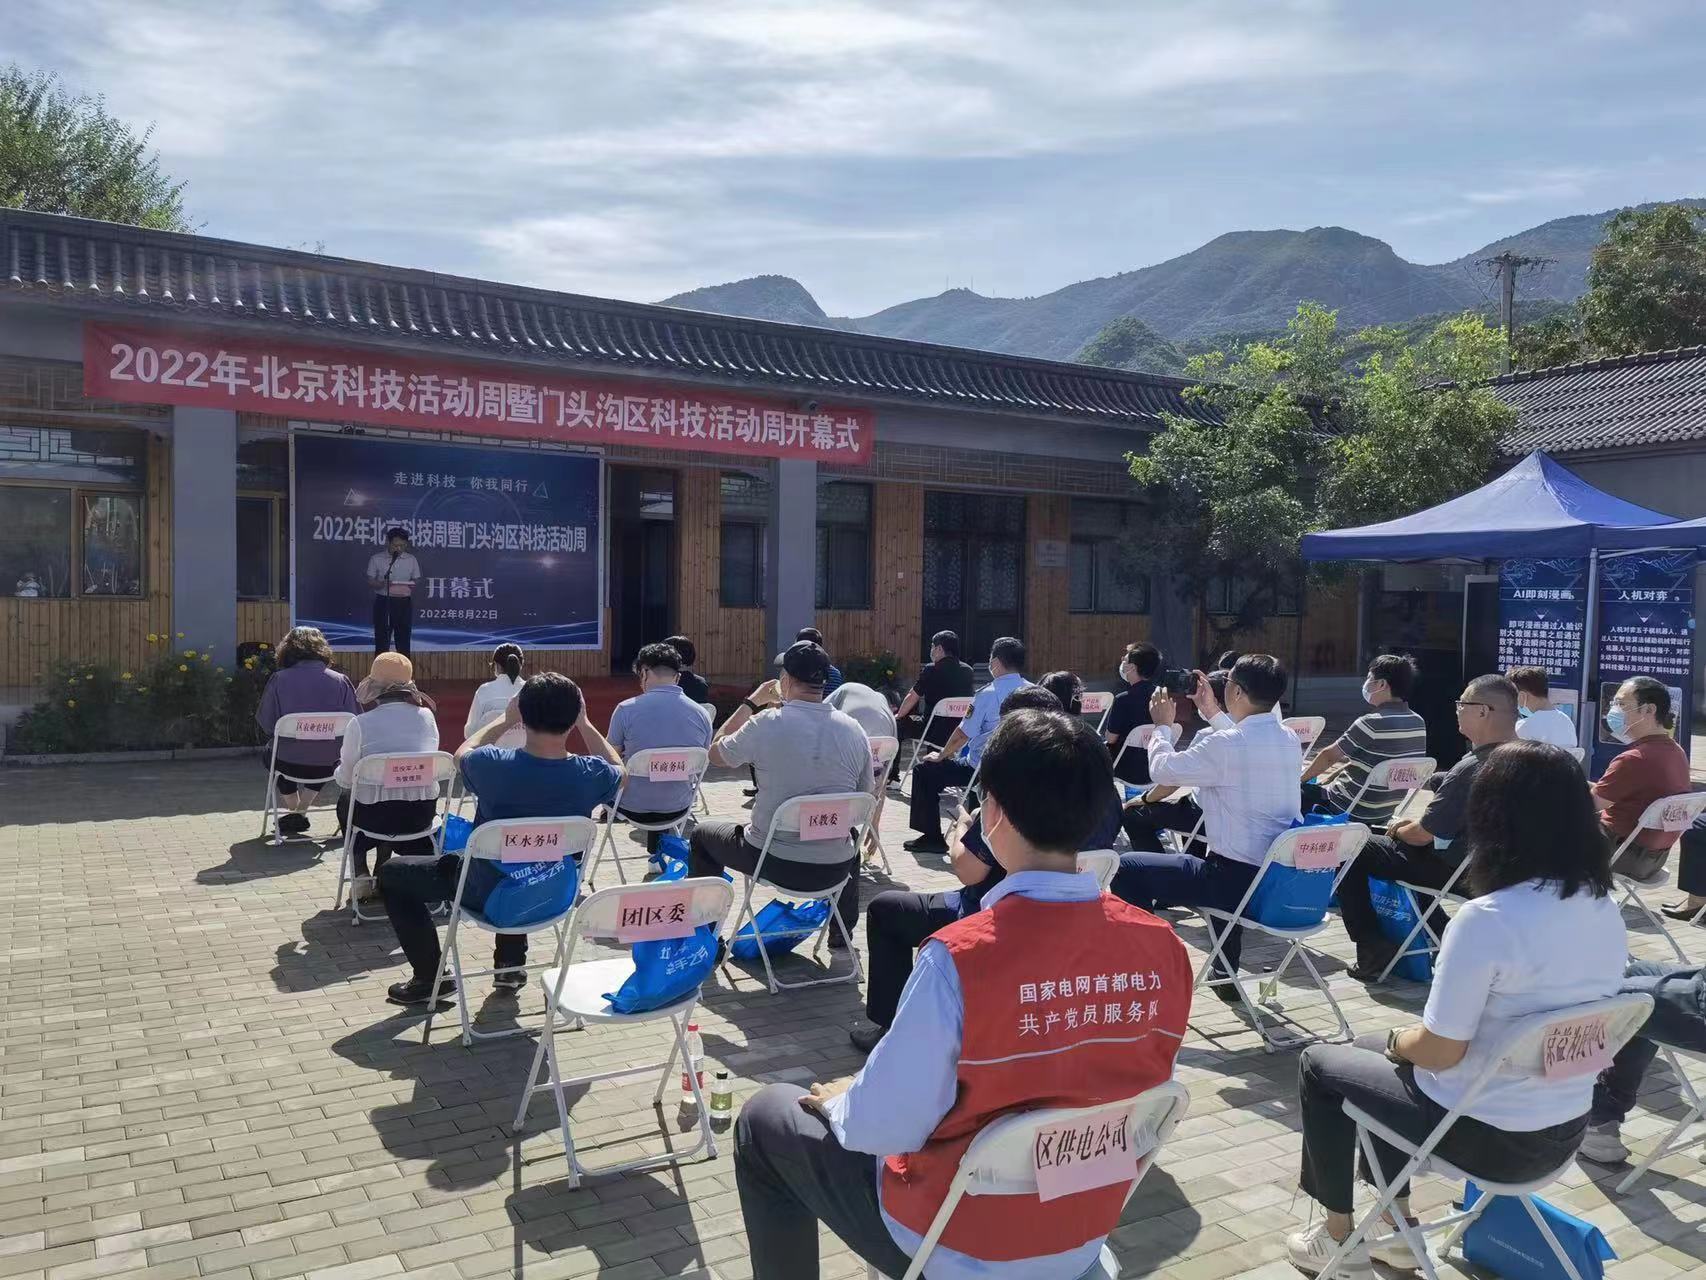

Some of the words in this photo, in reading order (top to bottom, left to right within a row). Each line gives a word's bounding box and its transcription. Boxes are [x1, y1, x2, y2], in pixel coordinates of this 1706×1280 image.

[110, 343, 860, 453] 2022年北京科技活动周暨门头沟区科技活动周开幕式
[393, 471, 456, 488] 走进科技
[470, 475, 528, 493] 你我同行
[426, 577, 495, 599] 开幕式
[1618, 590, 1668, 601] 人机对弈
[419, 609, 498, 620] 2022年8月22日
[650, 760, 685, 773] 区商务局
[809, 812, 838, 827] 区教委
[505, 832, 558, 848] 区水务局
[622, 902, 686, 928] 团区委
[1019, 970, 1162, 1004] 国家电网首都电力
[1018, 1000, 1159, 1037] 共产党员服务队
[1036, 1114, 1128, 1170] 区供电公司
